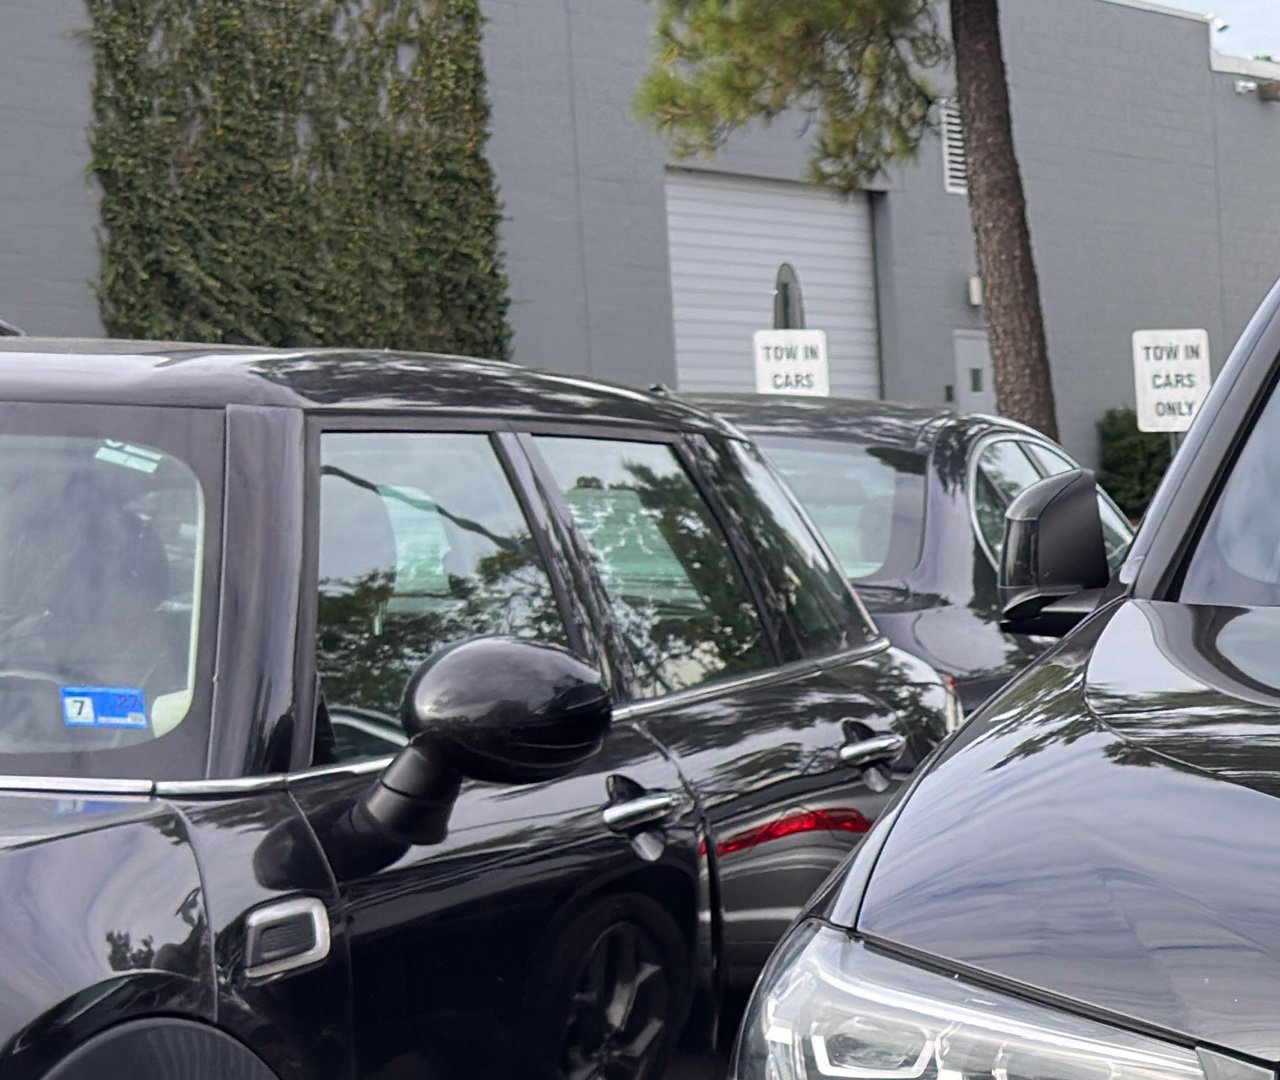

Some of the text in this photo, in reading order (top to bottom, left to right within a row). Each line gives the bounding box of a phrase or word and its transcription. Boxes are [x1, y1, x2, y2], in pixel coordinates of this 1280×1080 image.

[763, 344, 819, 360] TOW IN
[1143, 344, 1201, 361] TOW IN
[772, 373, 814, 389] CARS
[1151, 373, 1196, 389] CARS
[1155, 401, 1195, 417] ONLY
[73, 700, 86, 716] 7
